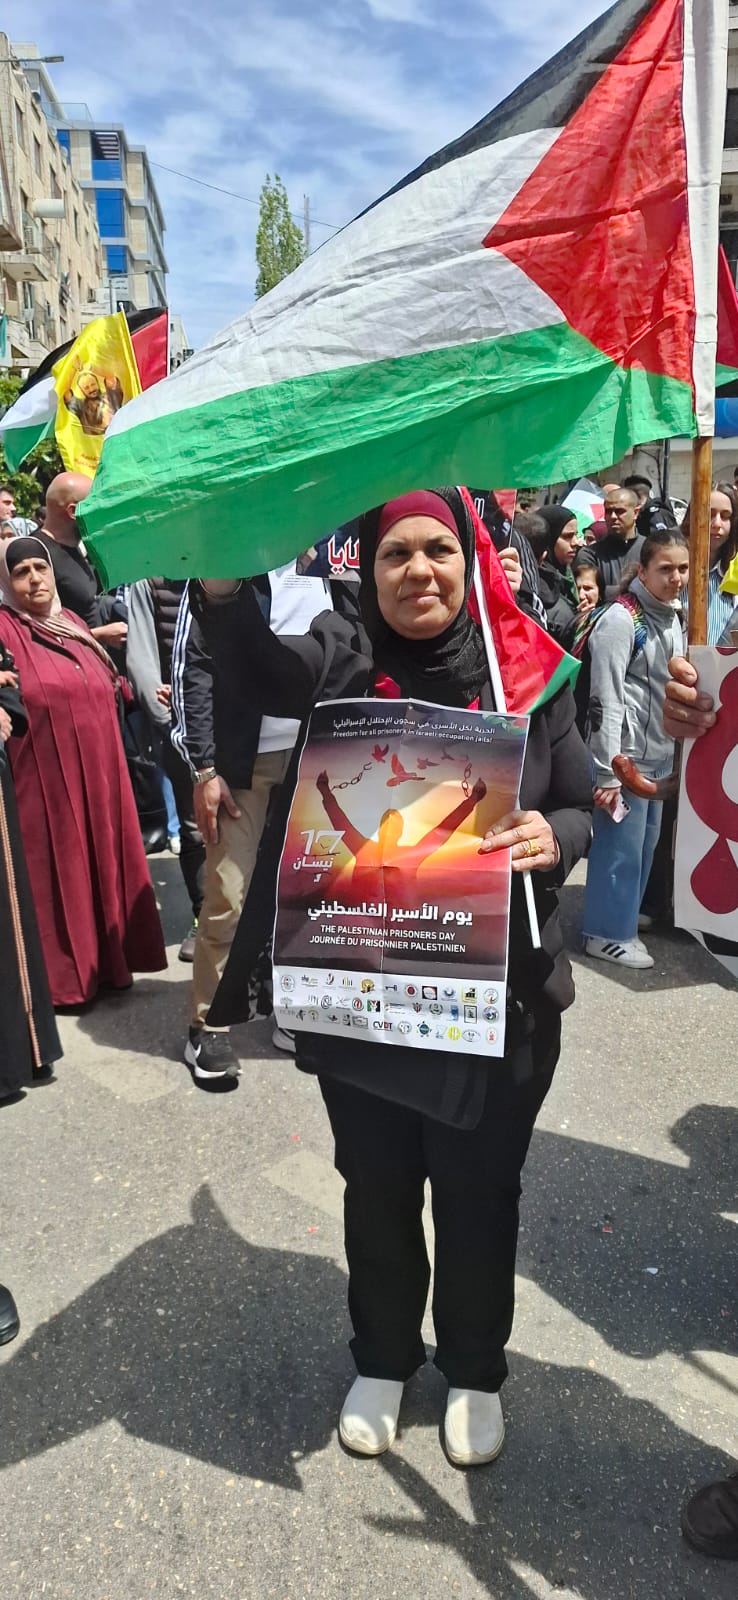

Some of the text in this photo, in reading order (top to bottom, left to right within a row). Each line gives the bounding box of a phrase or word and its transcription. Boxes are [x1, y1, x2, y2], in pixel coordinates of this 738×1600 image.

[393, 717, 416, 726] سجون
[458, 724, 473, 732] لكل
[333, 730, 358, 738] Freedom
[377, 727, 407, 736] prisoners
[438, 732, 474, 742] occupation
[301, 829, 346, 855] 17
[307, 900, 473, 926] يوم الأسير الفلسطيني
[320, 924, 456, 941] THE PALESTINIAN PRISONERS DAY
[309, 934, 466, 953] JOURNÉE DU PRISONNIER PALESTINIEN
